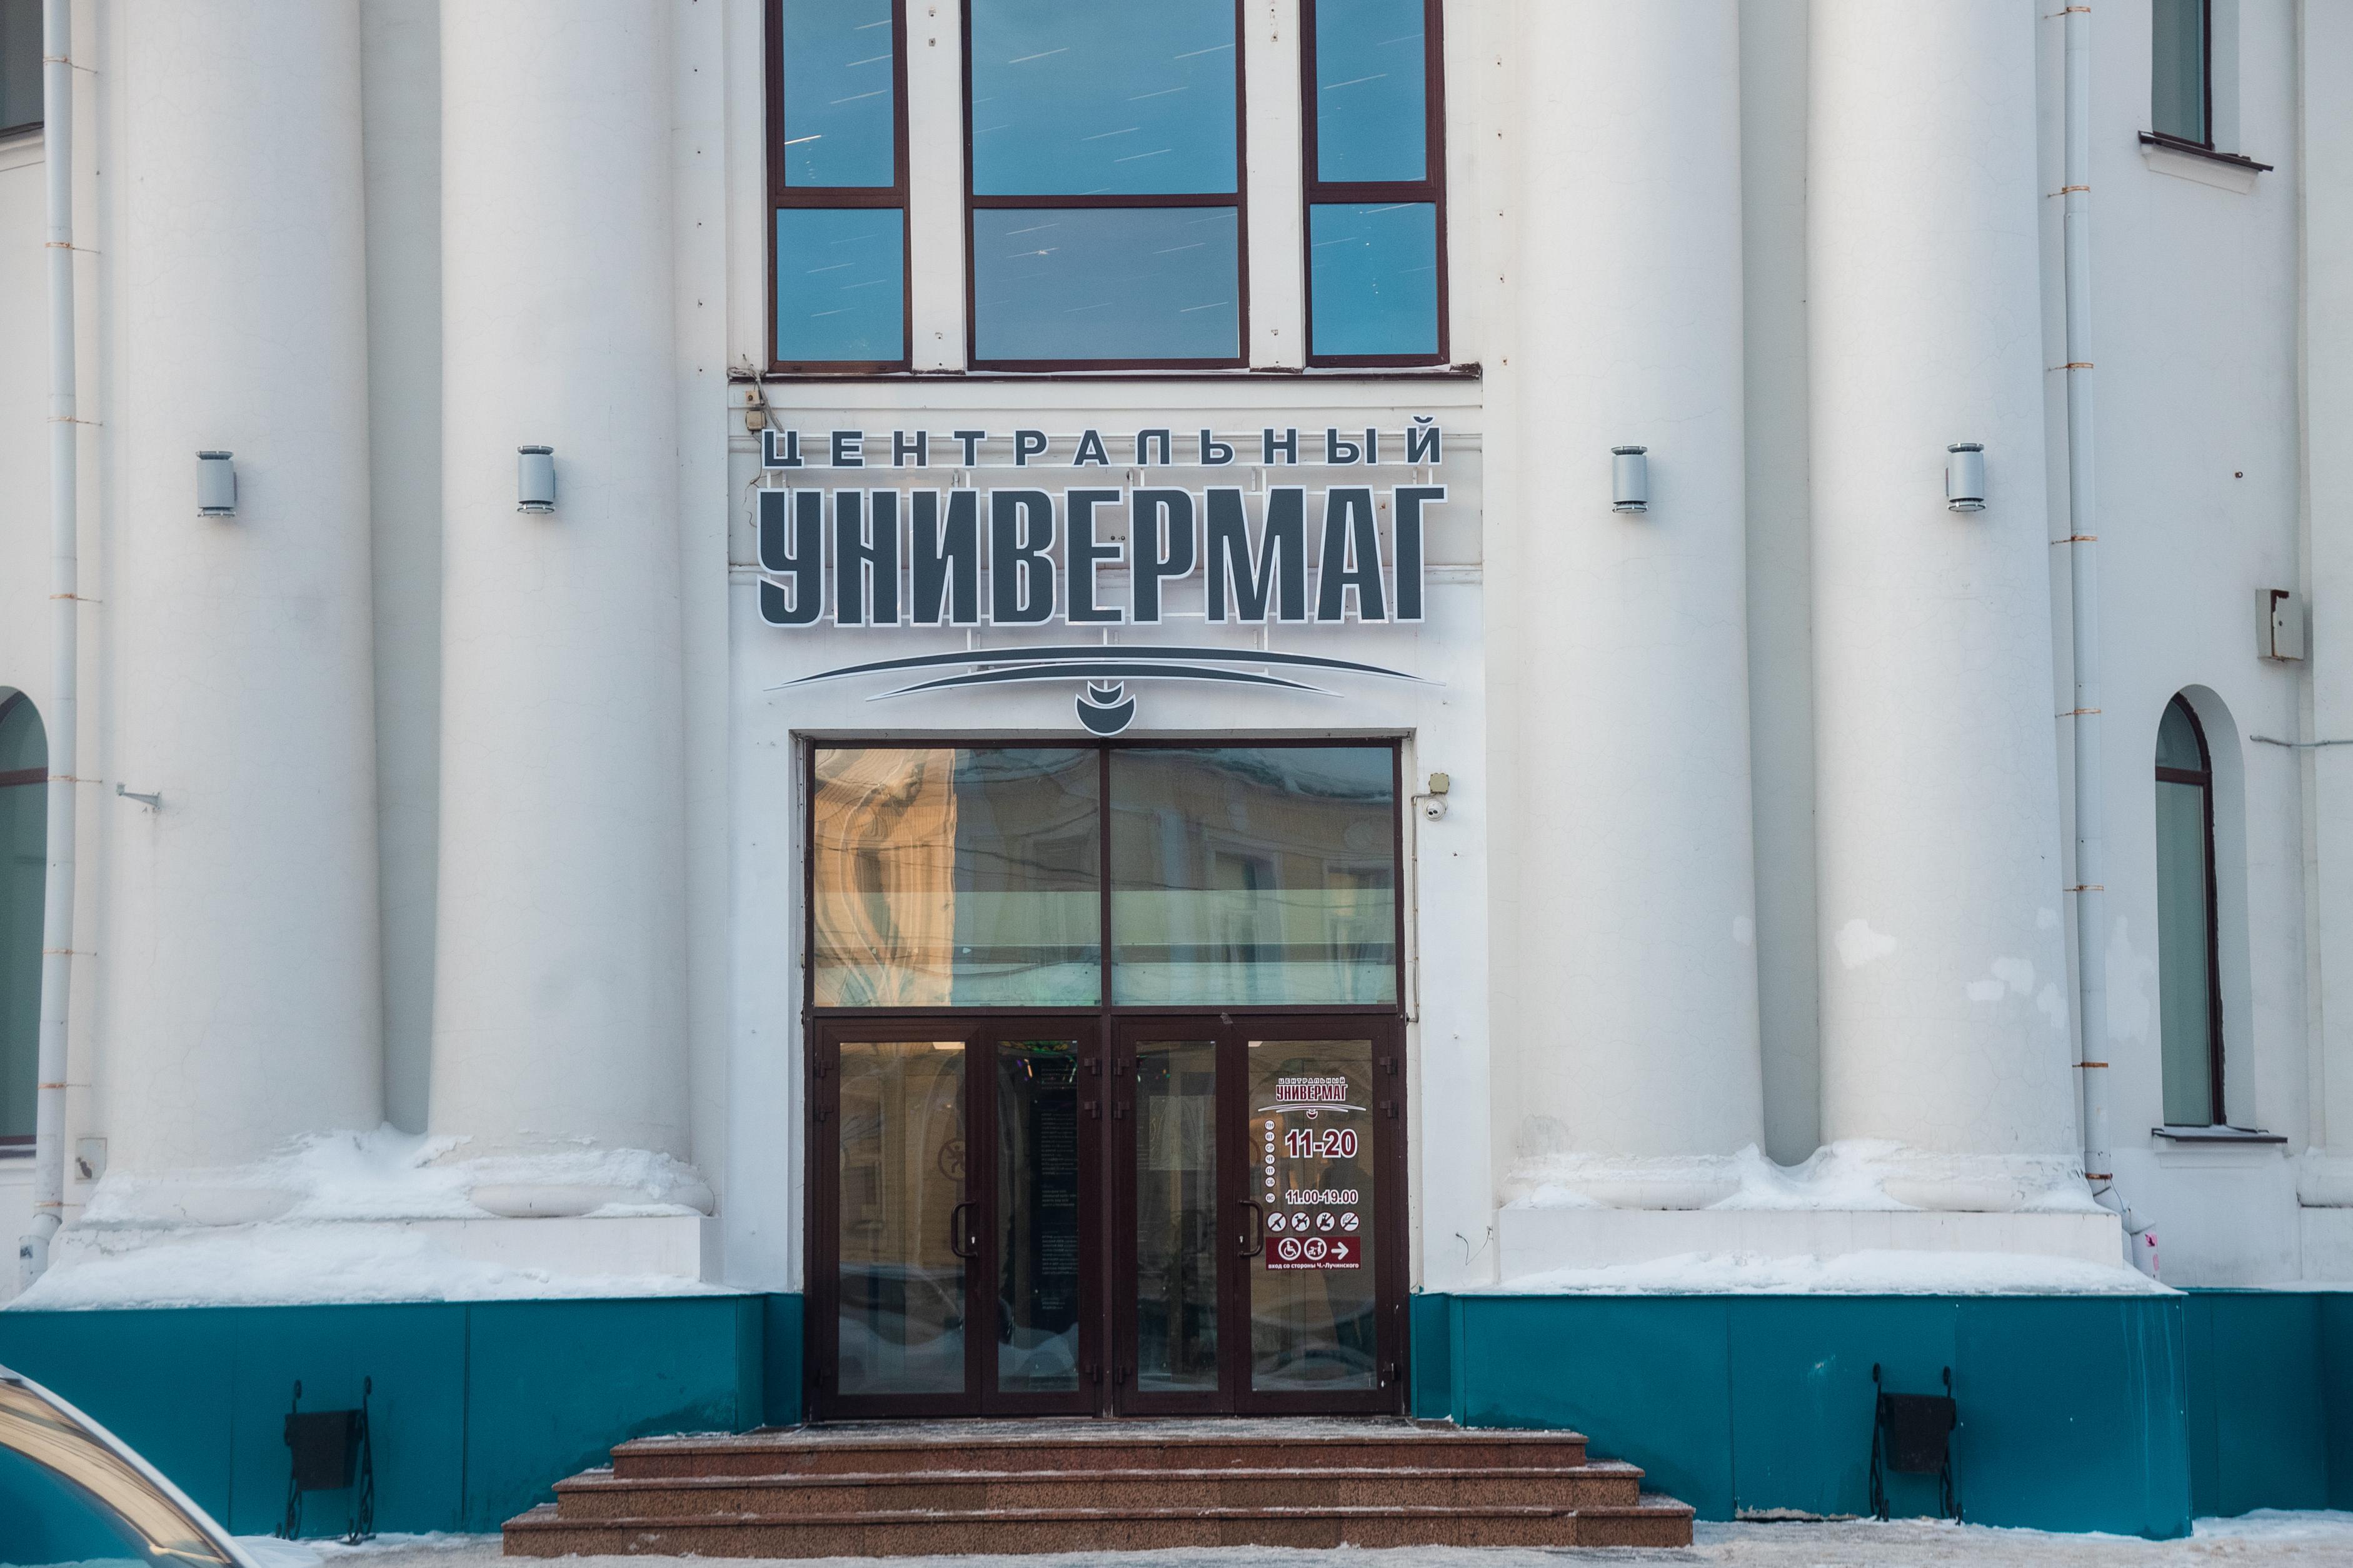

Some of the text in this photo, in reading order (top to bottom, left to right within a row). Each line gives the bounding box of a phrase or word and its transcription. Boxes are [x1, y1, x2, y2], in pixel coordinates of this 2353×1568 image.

[761, 415, 1443, 469] ЦЕНТРАЛЬНЫЙ
[756, 484, 1448, 627] УНИВЕРМАГ
[1276, 1084, 1348, 1101] УНИВЕРМАГ
[1285, 1129, 1358, 1158] 11-20
[1285, 1189, 1358, 1205] 11.00-19.00
